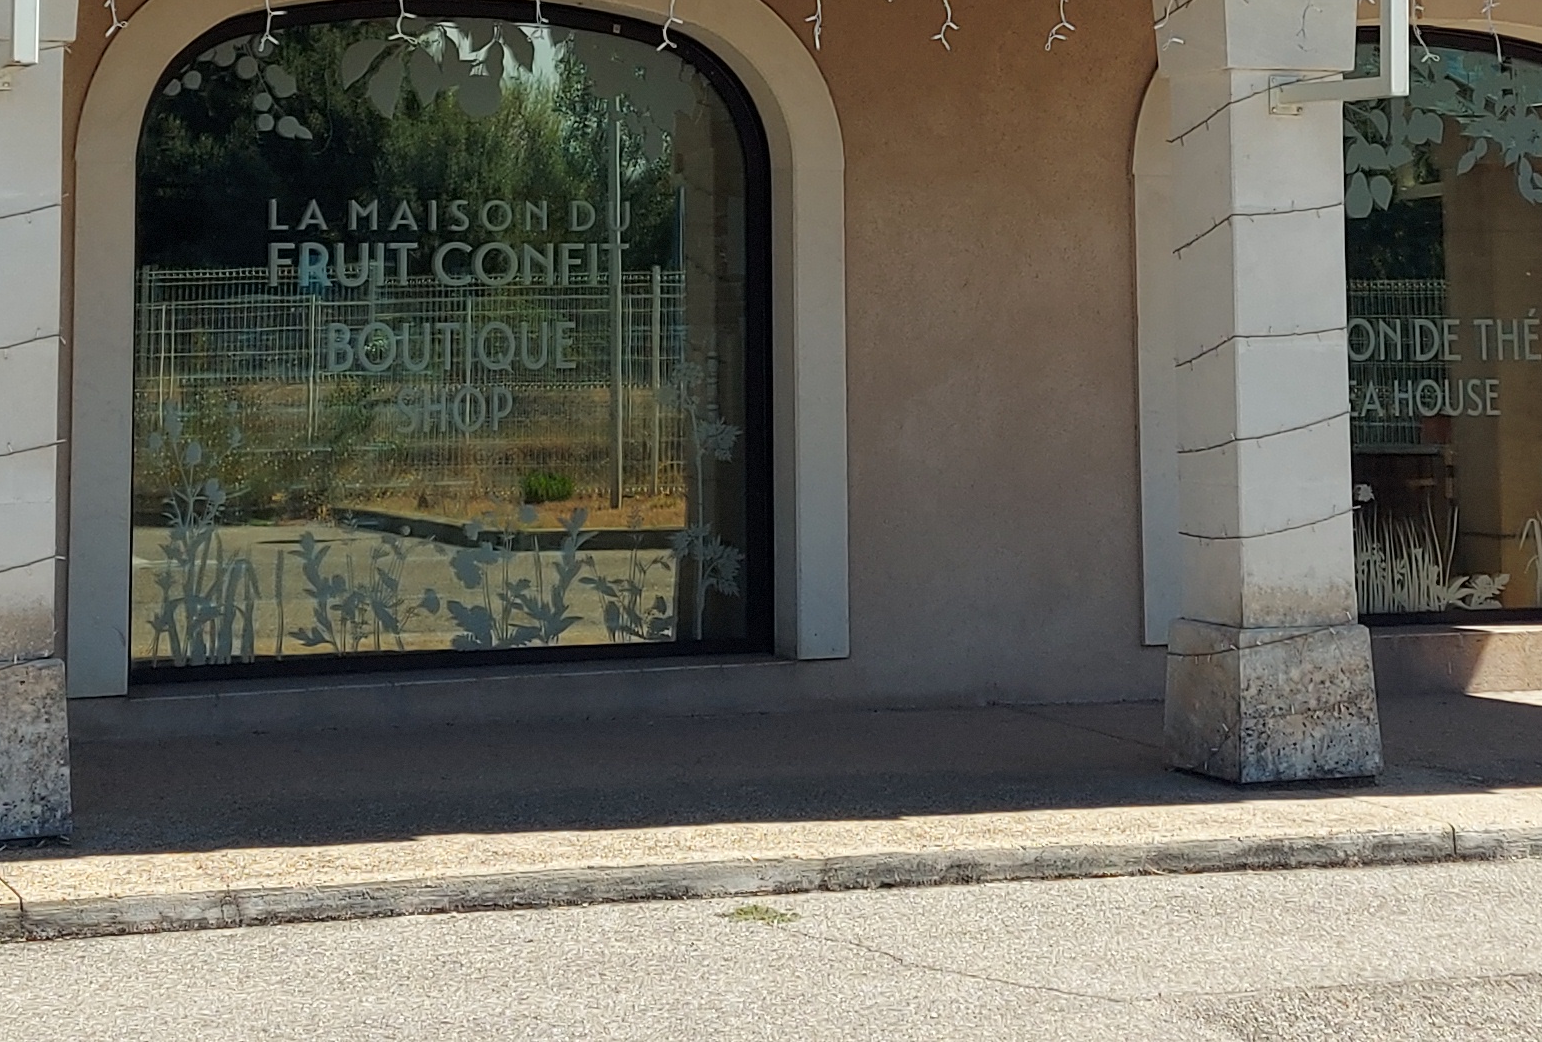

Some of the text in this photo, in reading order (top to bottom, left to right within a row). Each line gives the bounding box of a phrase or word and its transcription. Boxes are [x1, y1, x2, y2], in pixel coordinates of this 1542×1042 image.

[267, 198, 632, 232] LA MAISON DU
[267, 241, 630, 288] FRUIT CONFIT
[327, 320, 577, 374] BOUTIQUE
[1414, 318, 1462, 362] DE
[1473, 308, 1542, 361] THÉ
[396, 387, 514, 434] SHOP
[1393, 378, 1502, 417] HOUSE
